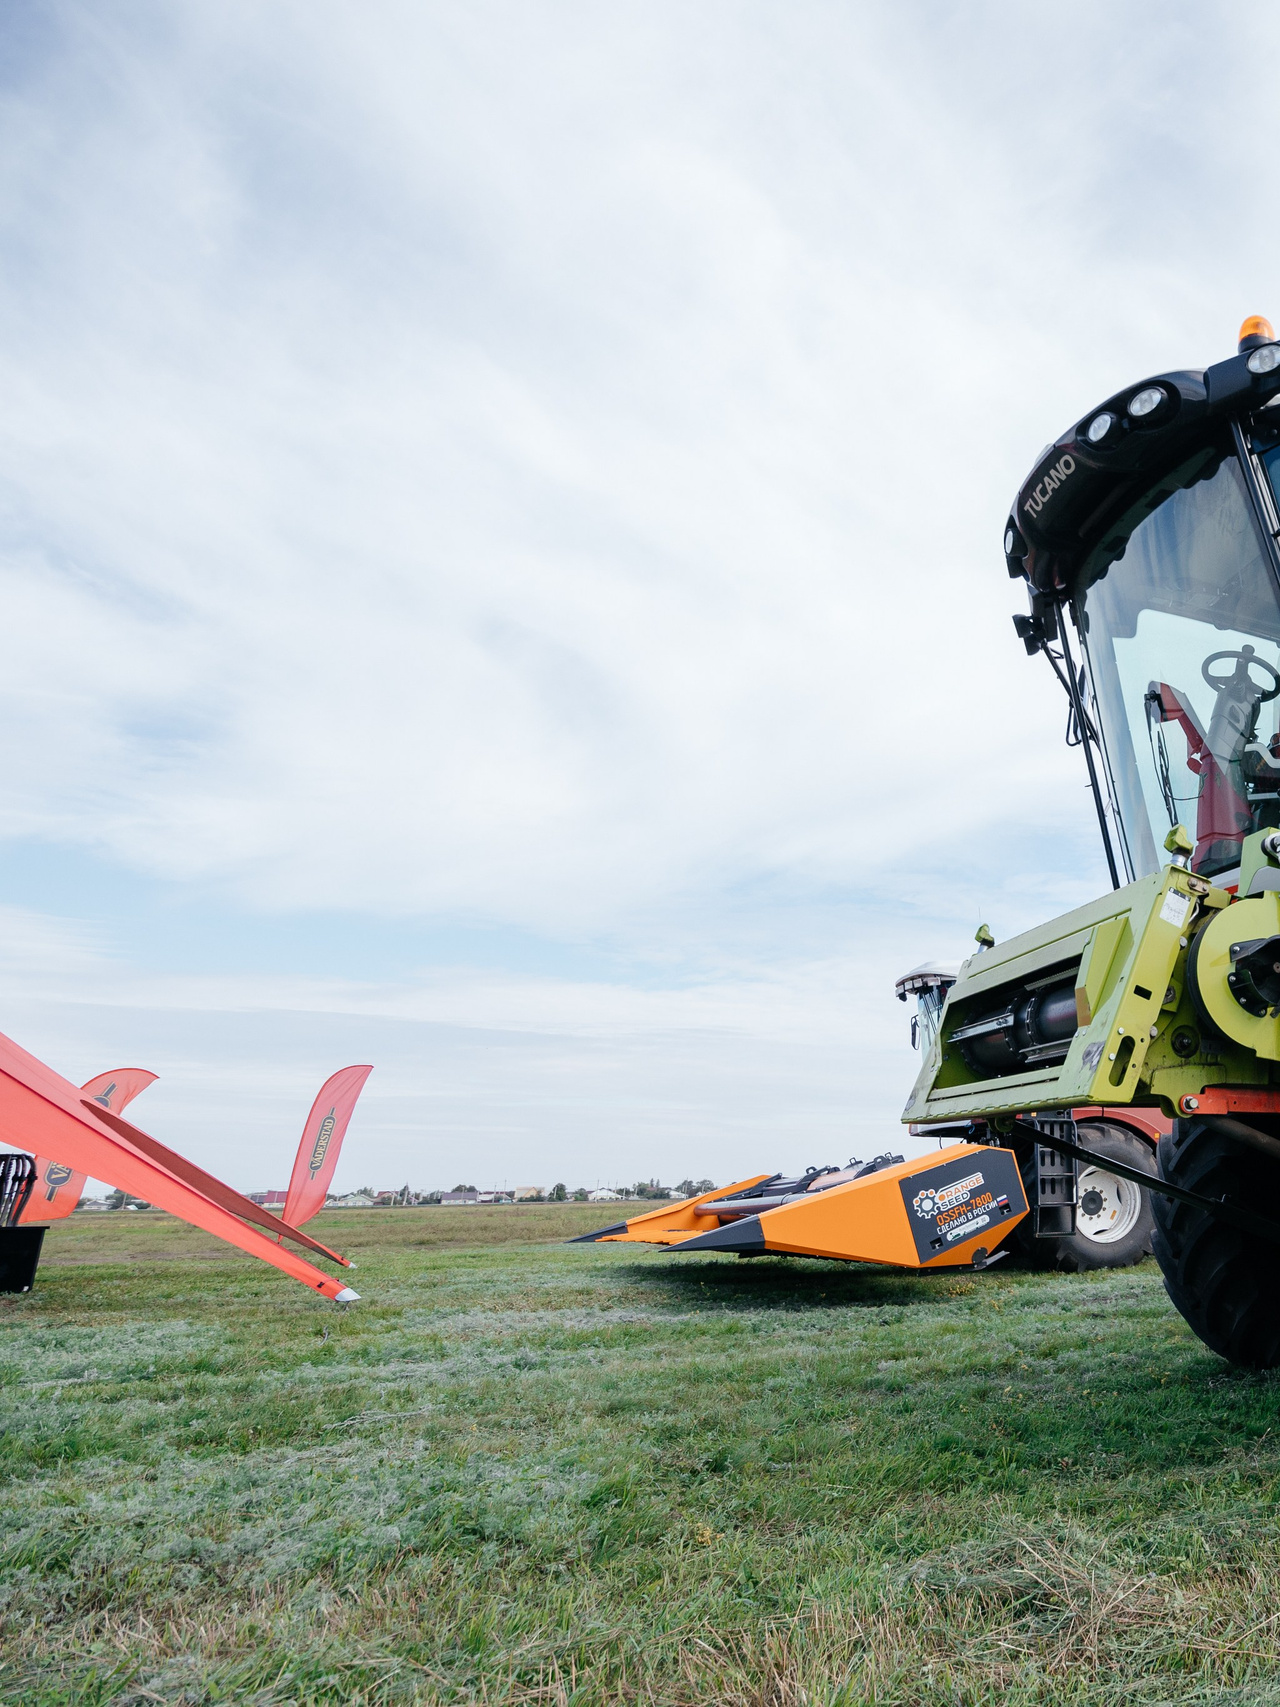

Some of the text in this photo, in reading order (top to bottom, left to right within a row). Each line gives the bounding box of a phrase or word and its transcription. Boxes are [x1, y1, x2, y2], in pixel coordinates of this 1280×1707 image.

[1023, 454, 1076, 519] TUCANO
[311, 1119, 334, 1168] VÄDERSTAD
[938, 1176, 983, 1202] ORANGE
[941, 1193, 969, 1210] SEED
[936, 1192, 993, 1226] OSSFH-7800
[936, 1216, 967, 1235] СДЕЛАНО
[967, 1212, 973, 1220] В
[973, 1199, 998, 1217] РОССИИ
